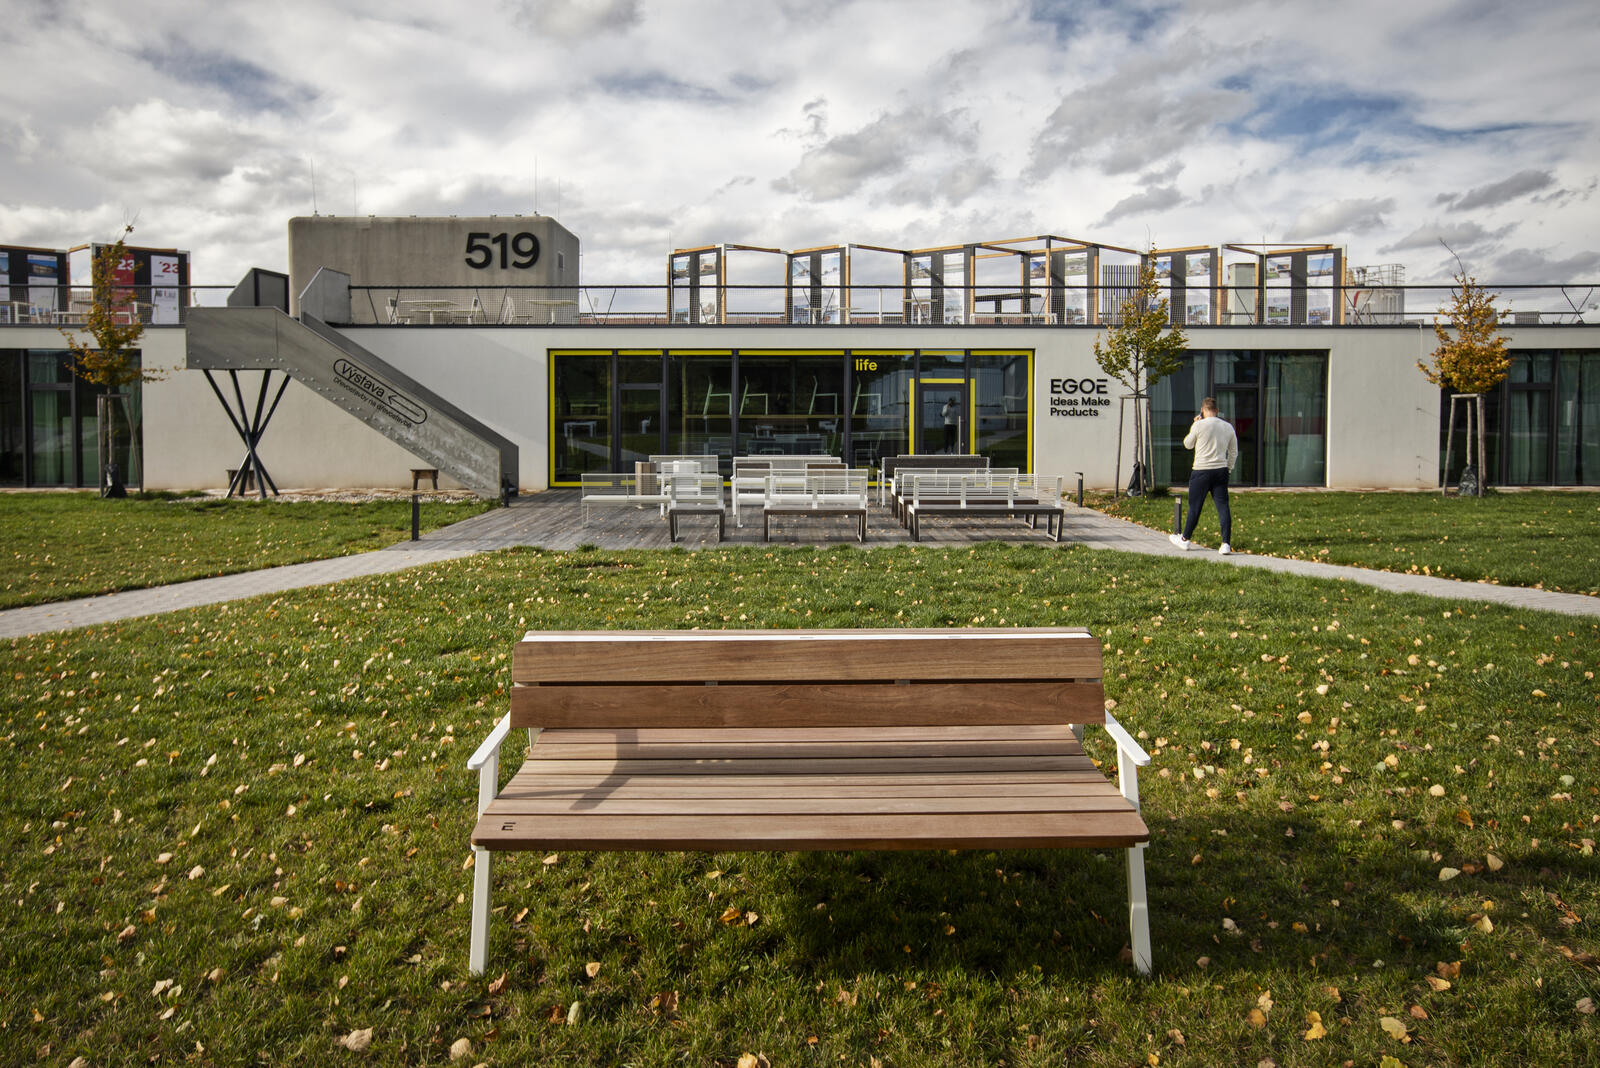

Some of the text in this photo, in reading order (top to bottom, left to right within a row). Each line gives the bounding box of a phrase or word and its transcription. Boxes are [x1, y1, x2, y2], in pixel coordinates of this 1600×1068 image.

[465, 232, 541, 269] 519
[855, 359, 878, 371] life
[341, 363, 385, 398] Výstava
[1050, 378, 1108, 394] EGOE
[1050, 397, 1111, 406] Ideas Make
[1050, 407, 1099, 417] Products
